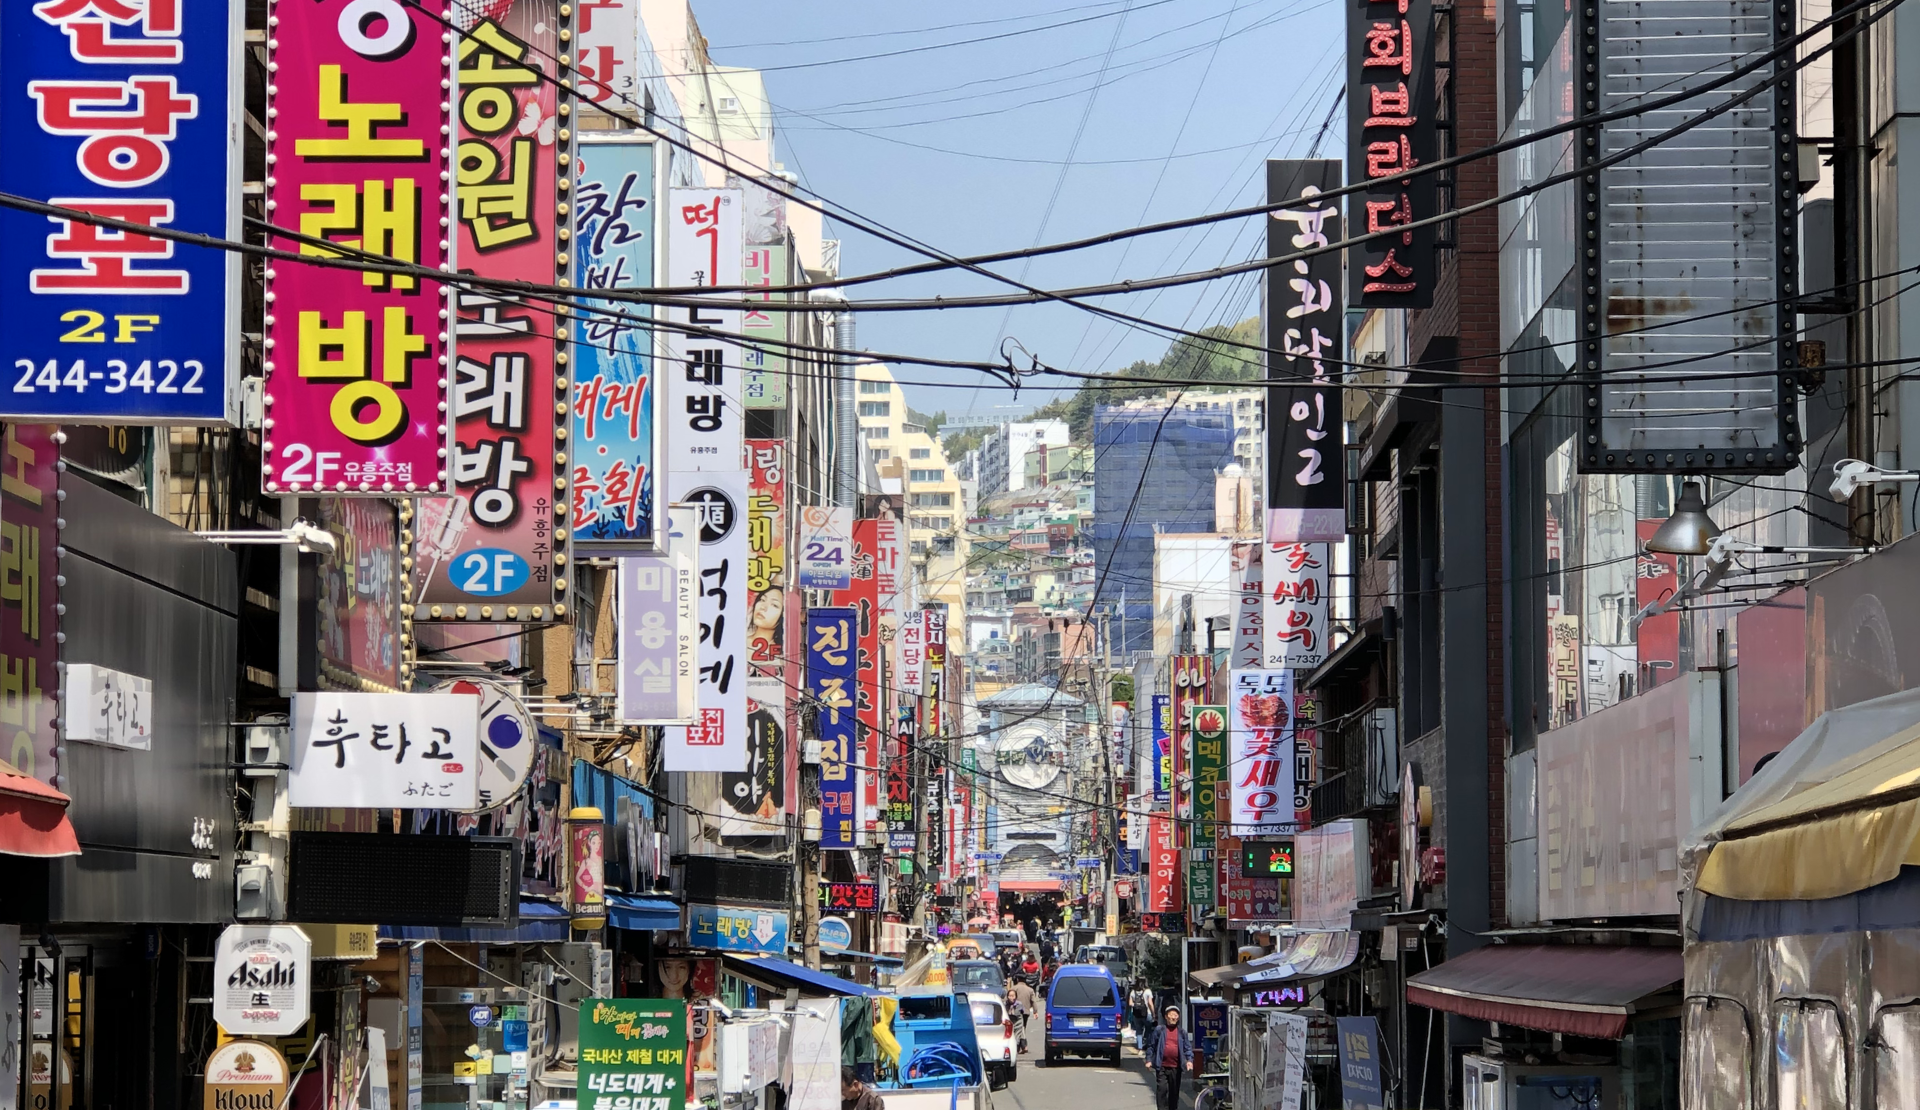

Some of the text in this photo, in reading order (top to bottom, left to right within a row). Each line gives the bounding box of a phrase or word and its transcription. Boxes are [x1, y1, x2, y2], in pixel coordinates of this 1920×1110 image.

[295, 65, 424, 440] 노래방
[59, 310, 160, 343] 2F
[13, 359, 204, 394] 244-3422
[575, 377, 646, 439] 대게
[281, 444, 341, 482] 2F
[343, 462, 412, 482] 유흥주점
[532, 497, 549, 582] 유흥주점
[806, 543, 844, 565] 24
[463, 556, 515, 591] 2F
[635, 566, 672, 694] 미용실
[680, 569, 689, 677] BEAUTY SALON
[752, 638, 782, 661] 2F
[904, 628, 921, 686] 전당포
[1270, 655, 1321, 664] 241-7337
[1238, 675, 1288, 695] 독도
[813, 620, 853, 781] 진주집
[312, 709, 453, 768] 후타고
[688, 726, 722, 744] 포차
[1240, 727, 1283, 821] 꽃새우
[402, 781, 454, 797] ふたご
[894, 833, 916, 841] EDIYA
[1157, 821, 1174, 908] 모텔 오아시스
[832, 885, 874, 908] 맛집
[697, 914, 752, 938] 노래방
[228, 960, 296, 989] Asahi
[252, 992, 270, 1006] 生
[473, 1011, 489, 1020] ADT
[582, 1049, 683, 1064] 국내산 제철 대게
[216, 1070, 273, 1082] Premium
